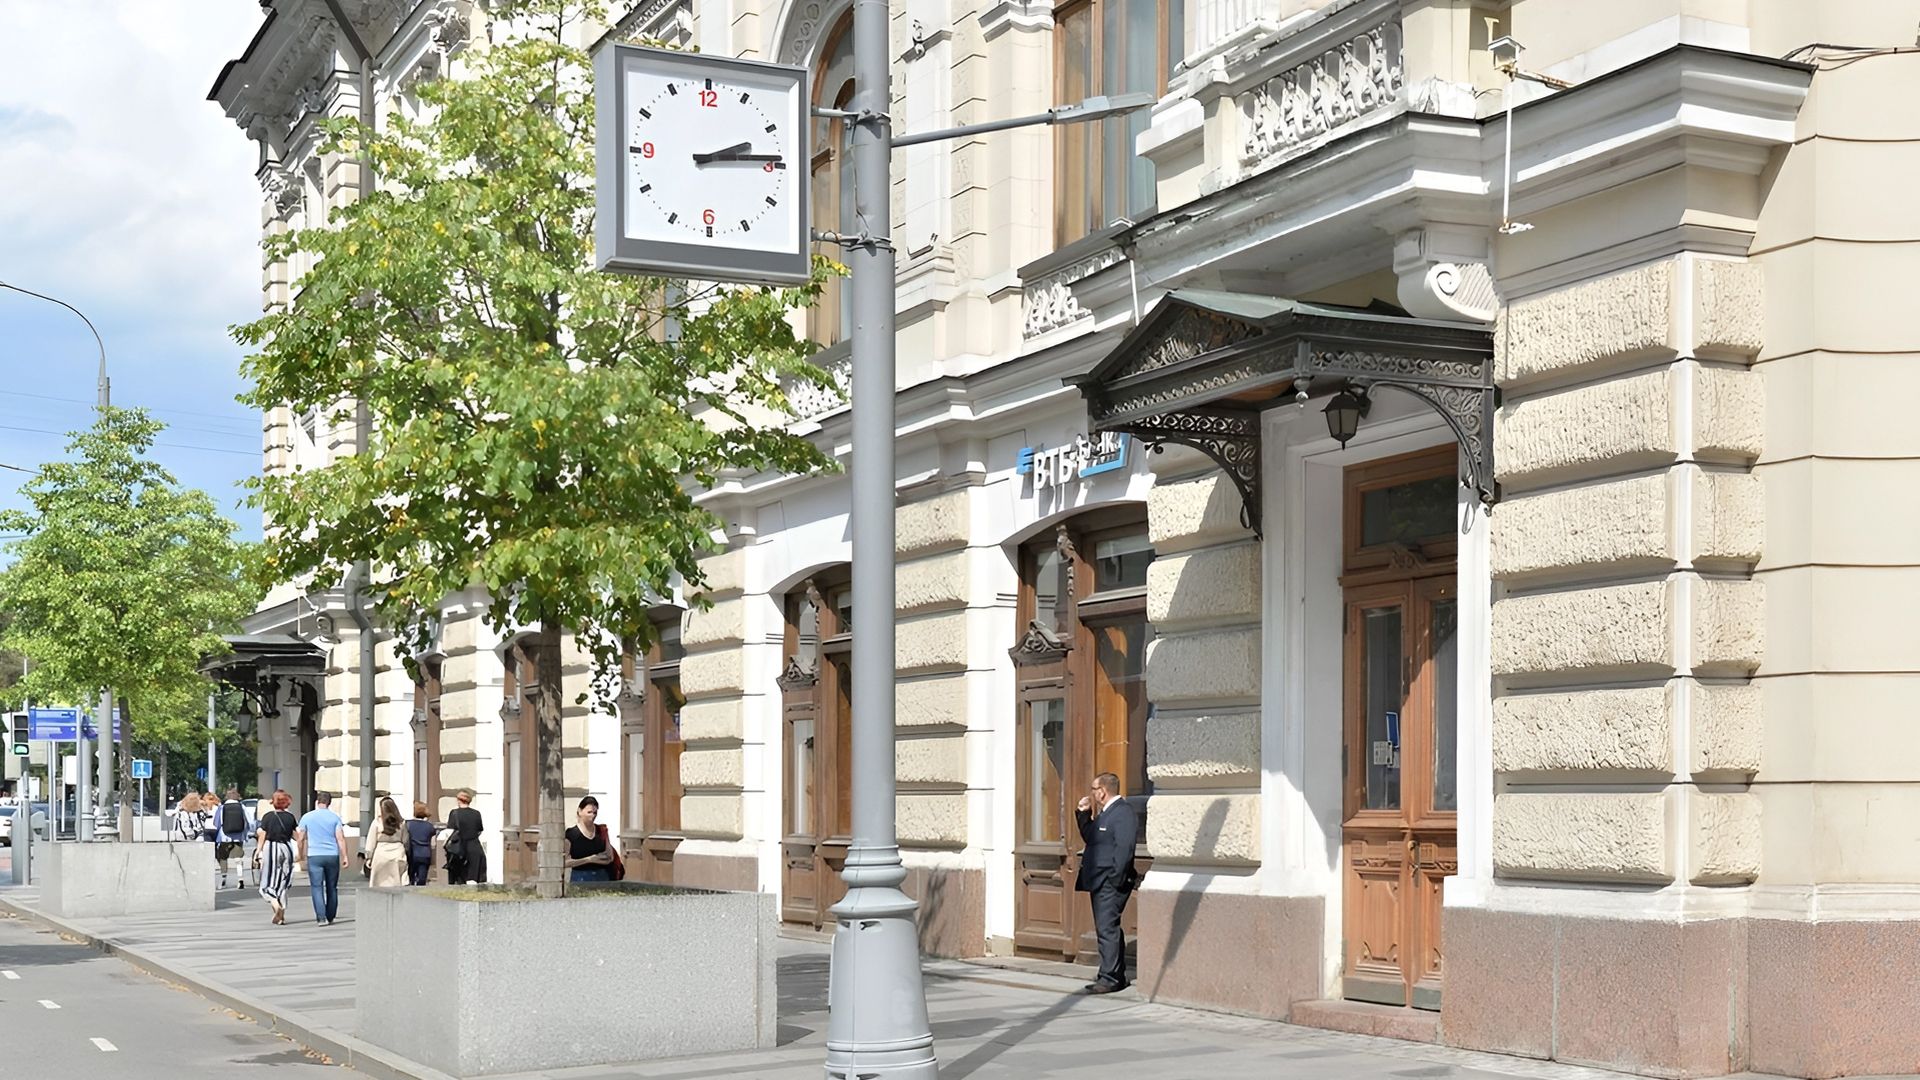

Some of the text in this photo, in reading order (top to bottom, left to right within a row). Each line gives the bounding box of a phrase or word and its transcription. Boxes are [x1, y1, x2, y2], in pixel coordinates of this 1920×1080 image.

[699, 90, 718, 108] 12
[643, 142, 655, 158] 9
[703, 210, 716, 225] 6
[1033, 443, 1073, 490] ВТБ
